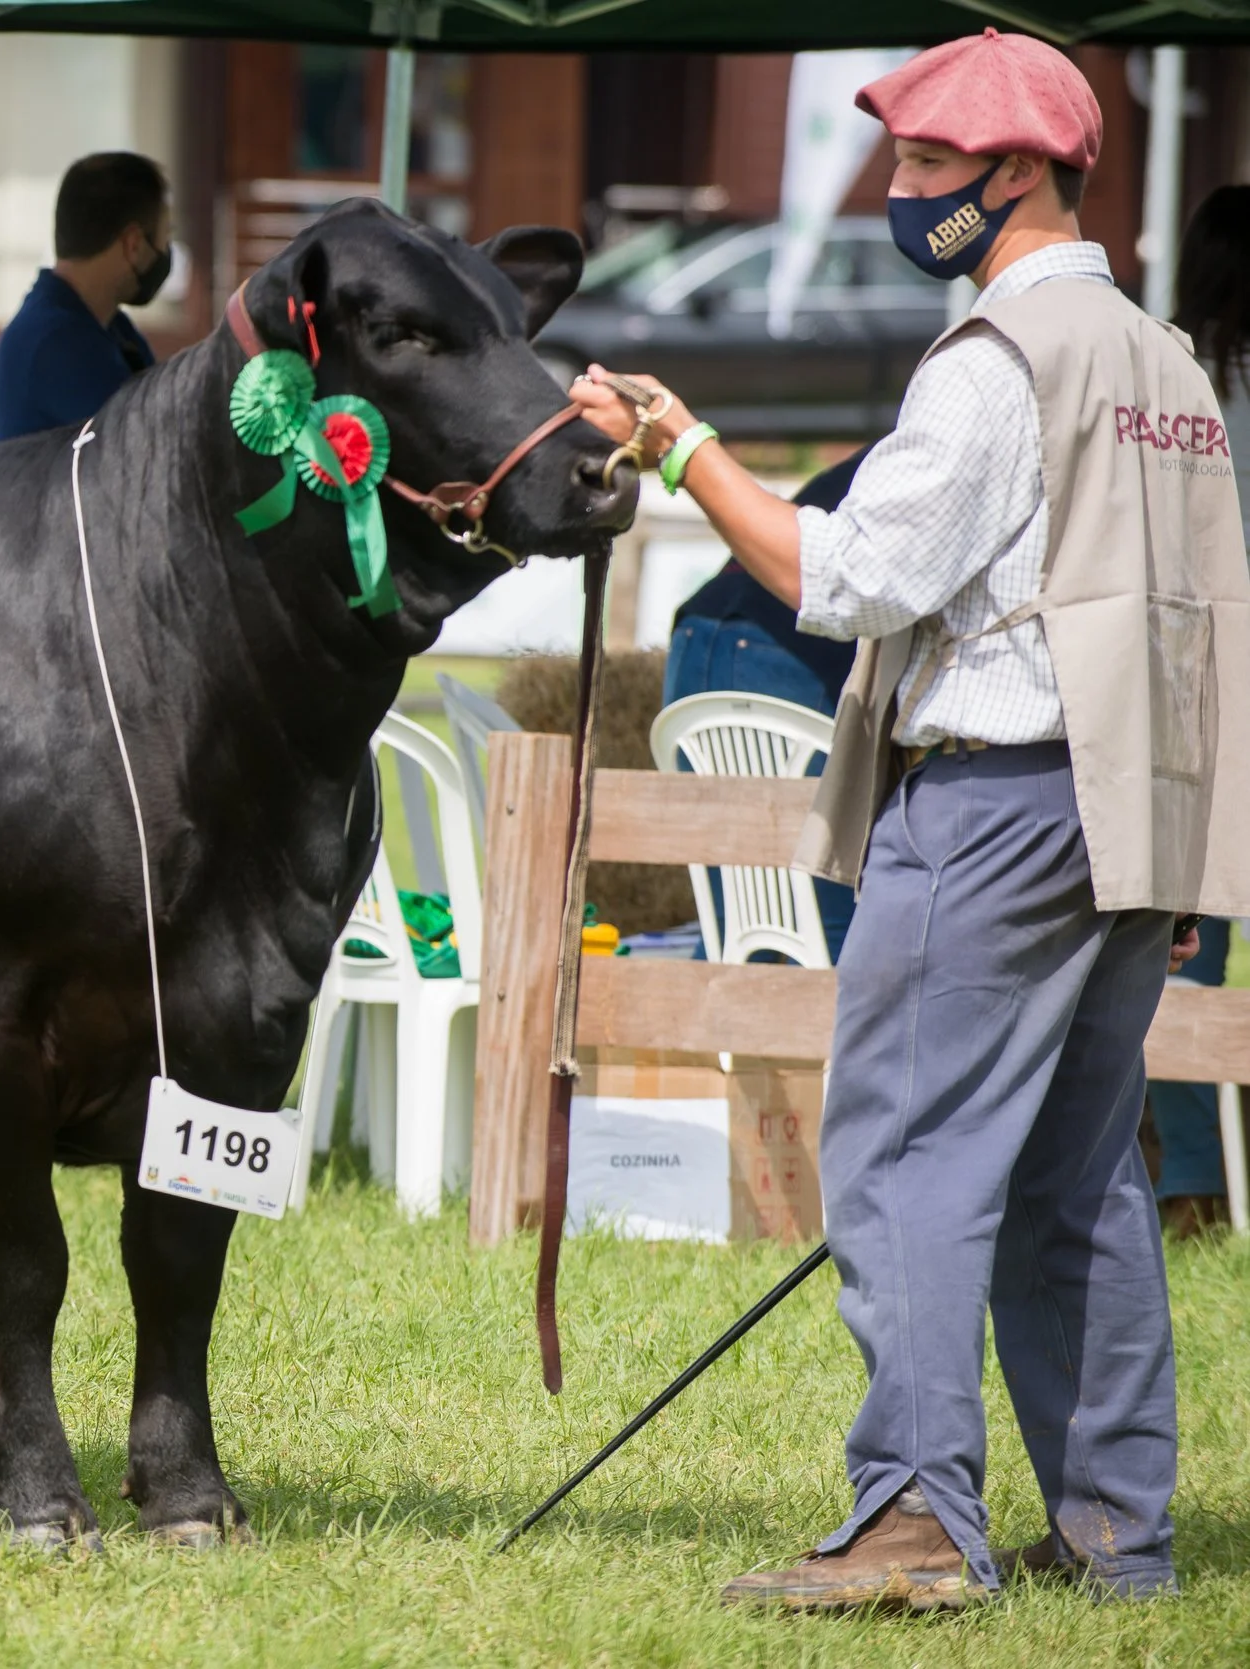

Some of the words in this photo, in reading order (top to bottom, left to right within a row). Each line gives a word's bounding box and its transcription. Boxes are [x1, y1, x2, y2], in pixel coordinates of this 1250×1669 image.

[926, 203, 981, 255] ABHB
[175, 1120, 271, 1173] 1198
[610, 1154, 681, 1169] COZINHA
